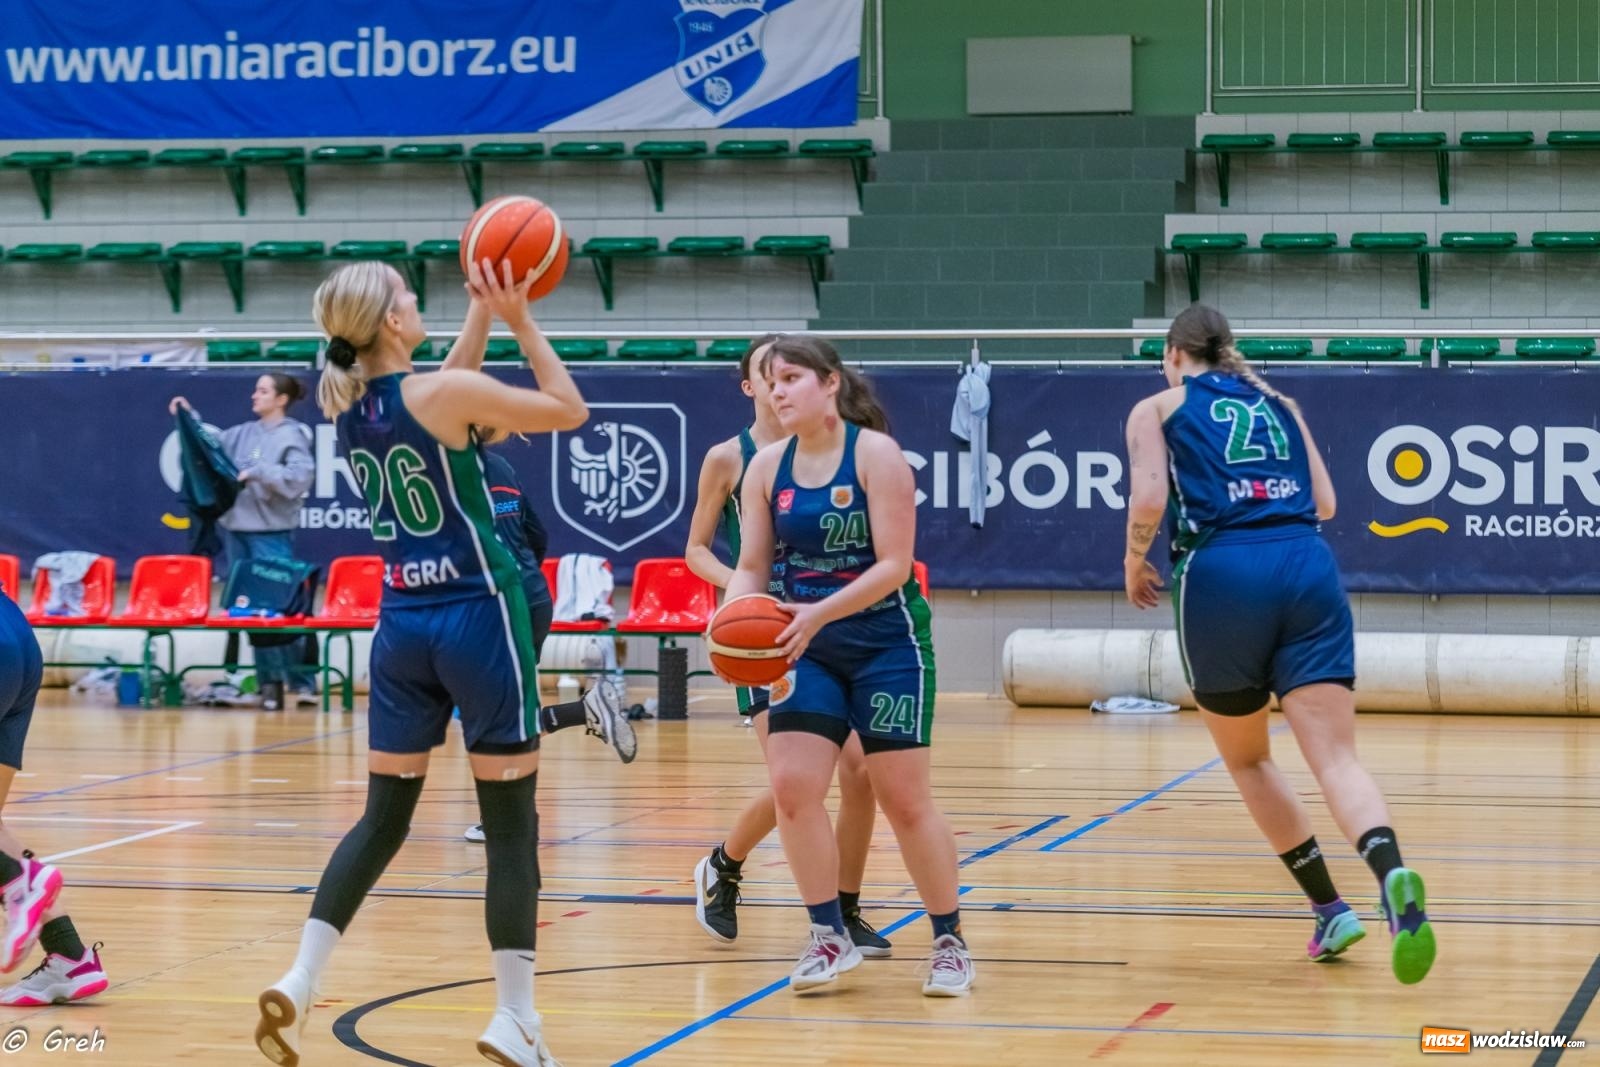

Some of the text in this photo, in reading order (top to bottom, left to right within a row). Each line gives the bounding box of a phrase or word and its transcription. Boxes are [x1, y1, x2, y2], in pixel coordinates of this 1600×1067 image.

[6, 26, 577, 84] www.uniaraciborz.eu
[684, 32, 755, 80] UNIA
[1210, 396, 1290, 465] 21
[351, 444, 444, 541] 26
[820, 511, 869, 553] 24
[1466, 508, 1600, 538] RACIBÓR
[870, 692, 915, 734] 24
